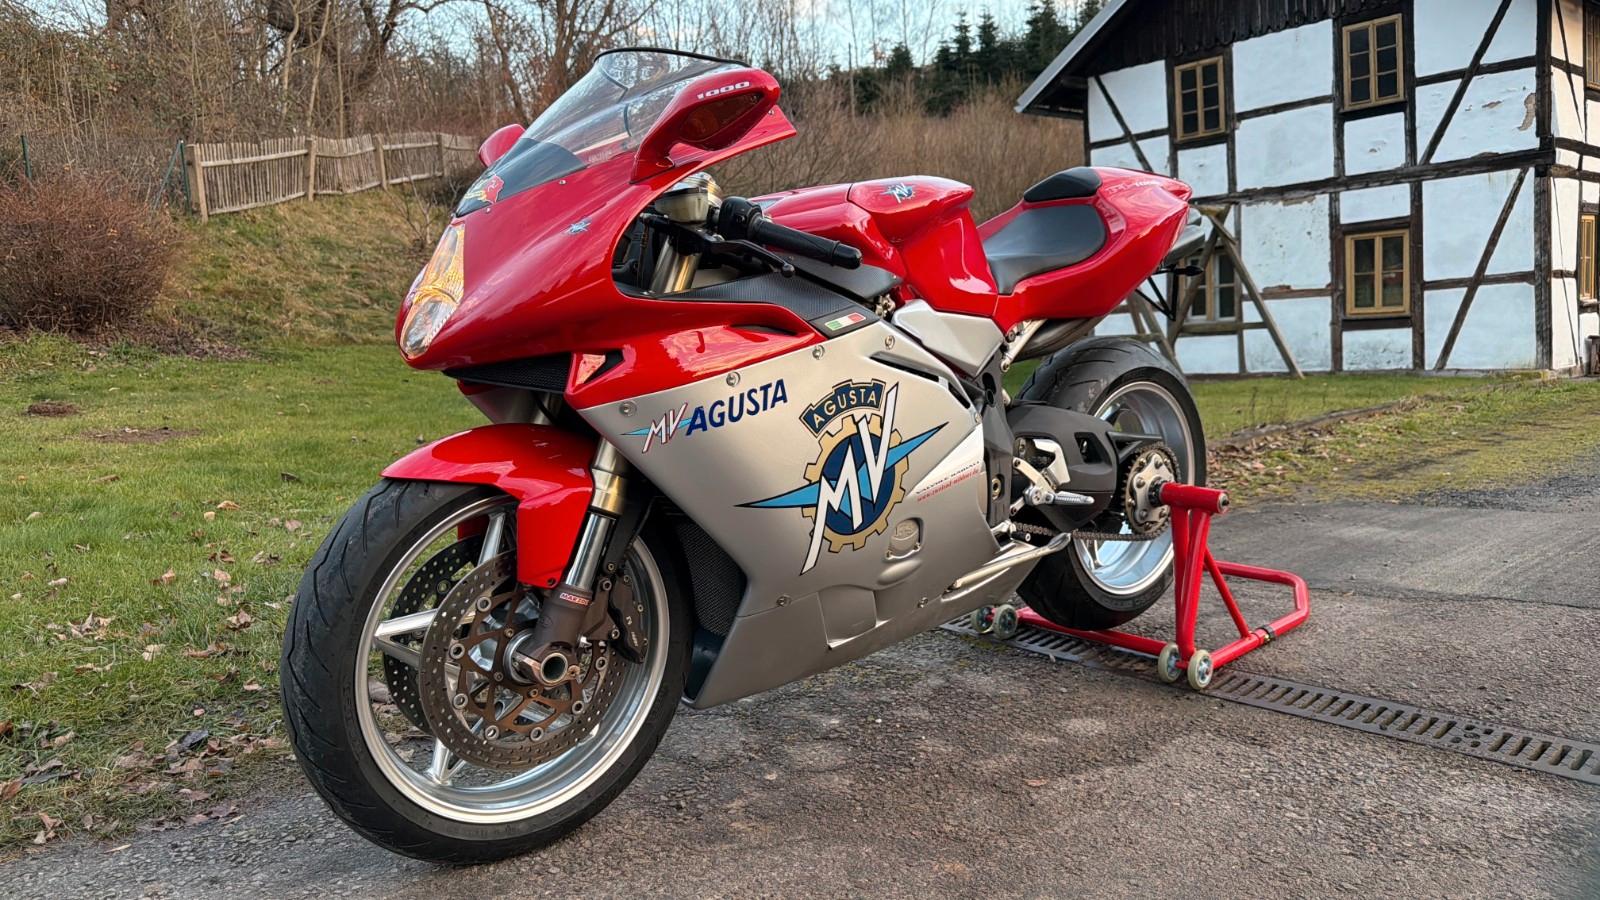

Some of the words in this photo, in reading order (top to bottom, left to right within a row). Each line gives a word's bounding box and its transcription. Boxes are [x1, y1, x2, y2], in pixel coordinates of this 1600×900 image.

[696, 81, 750, 100] 1000
[642, 402, 689, 454] MV
[685, 378, 788, 436] AGUSTA
[813, 388, 878, 429] AGUSTA
[799, 381, 899, 576] MV
